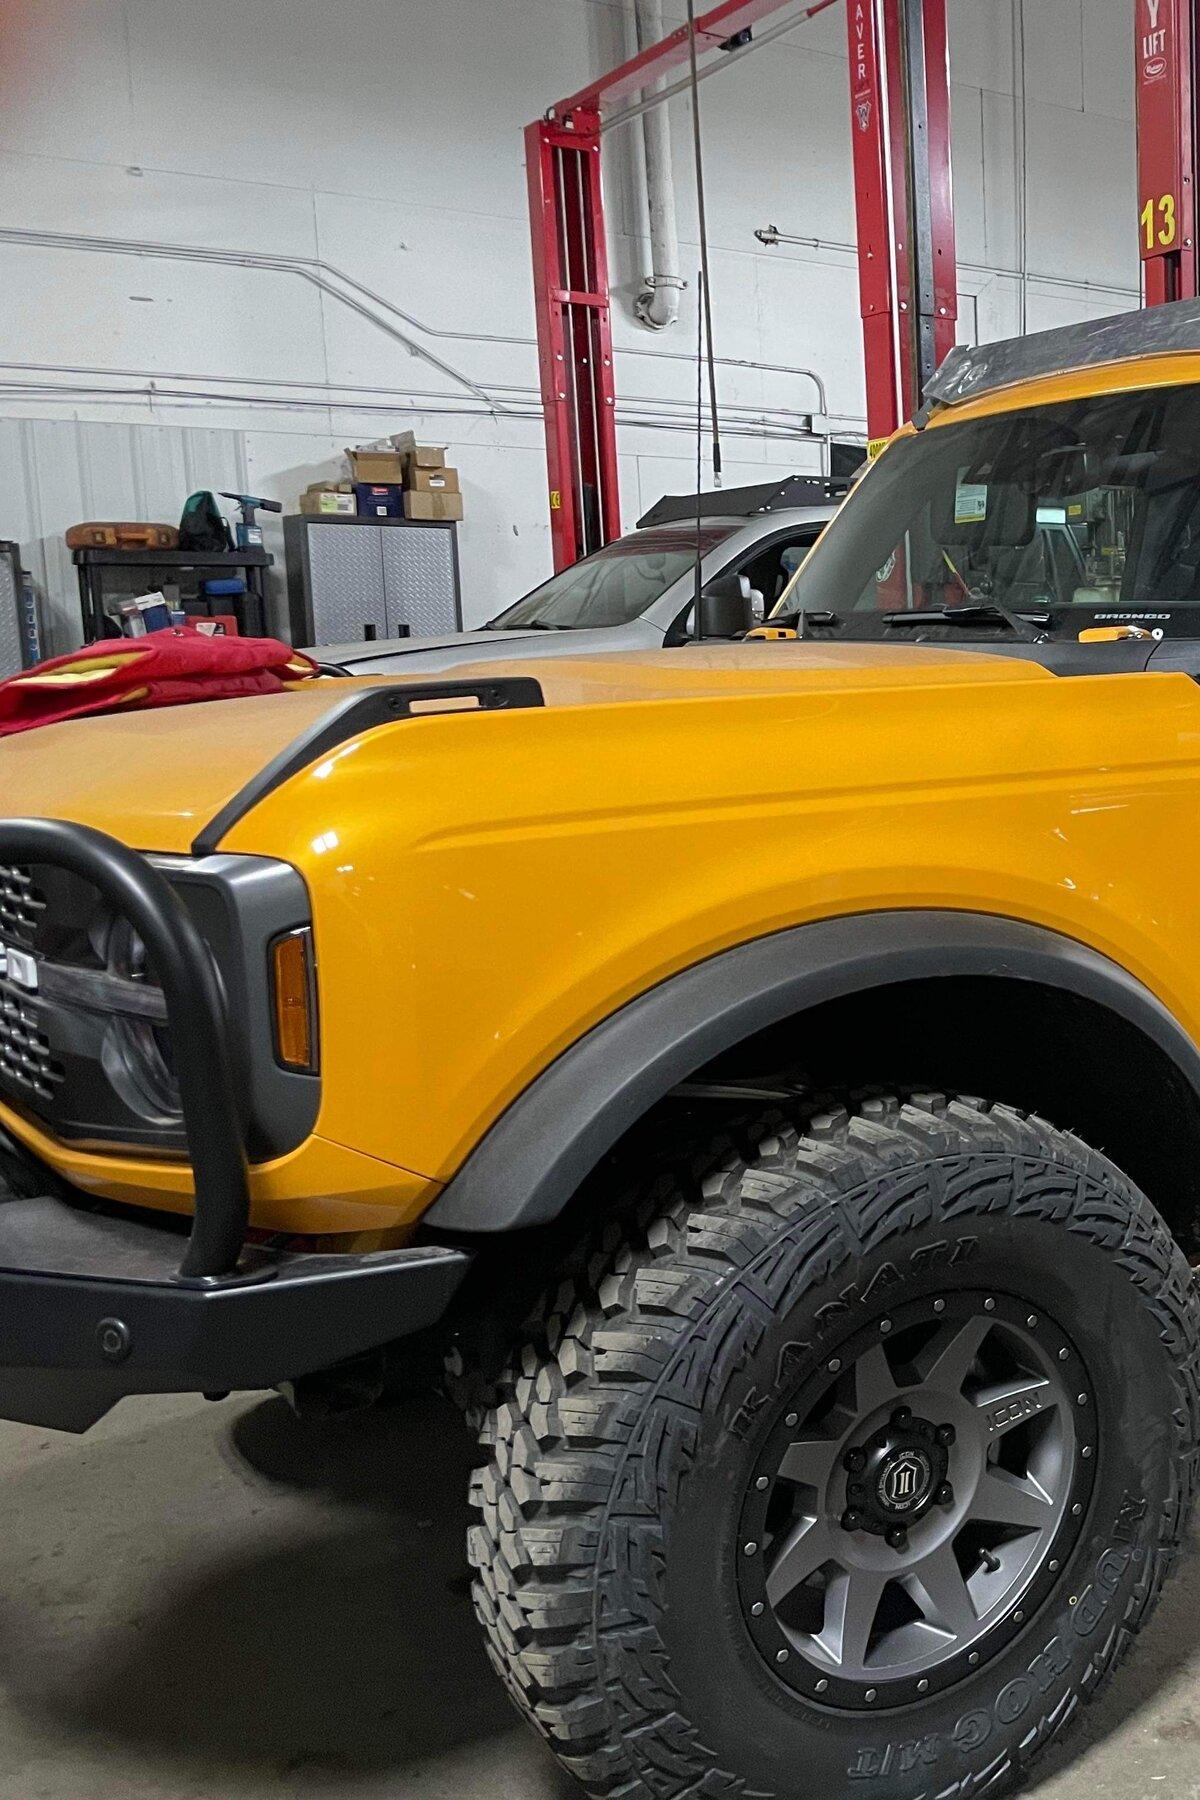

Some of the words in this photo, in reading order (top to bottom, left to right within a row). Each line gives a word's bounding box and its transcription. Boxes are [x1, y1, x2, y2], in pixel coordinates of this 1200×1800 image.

[856, 3, 867, 80] AVER
[1142, 28, 1165, 60] LIFT
[1141, 194, 1175, 249] 13
[986, 1391, 1043, 1432] ICON
[953, 1636, 1072, 1753] HOG
[846, 1733, 941, 1780] M/T
